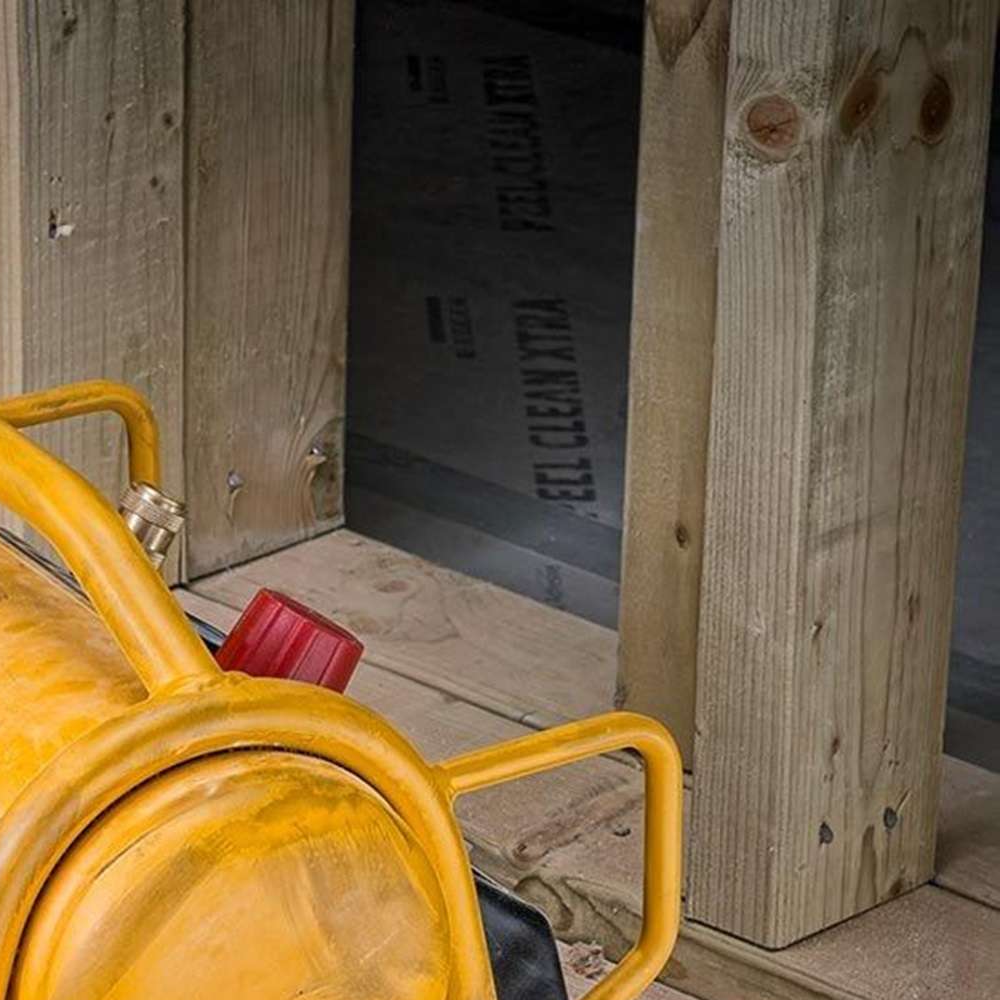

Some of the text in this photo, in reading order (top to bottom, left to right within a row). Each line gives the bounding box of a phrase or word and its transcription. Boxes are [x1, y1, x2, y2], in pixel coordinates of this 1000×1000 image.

[513, 299, 597, 516] EEL CLEAN XTRA
